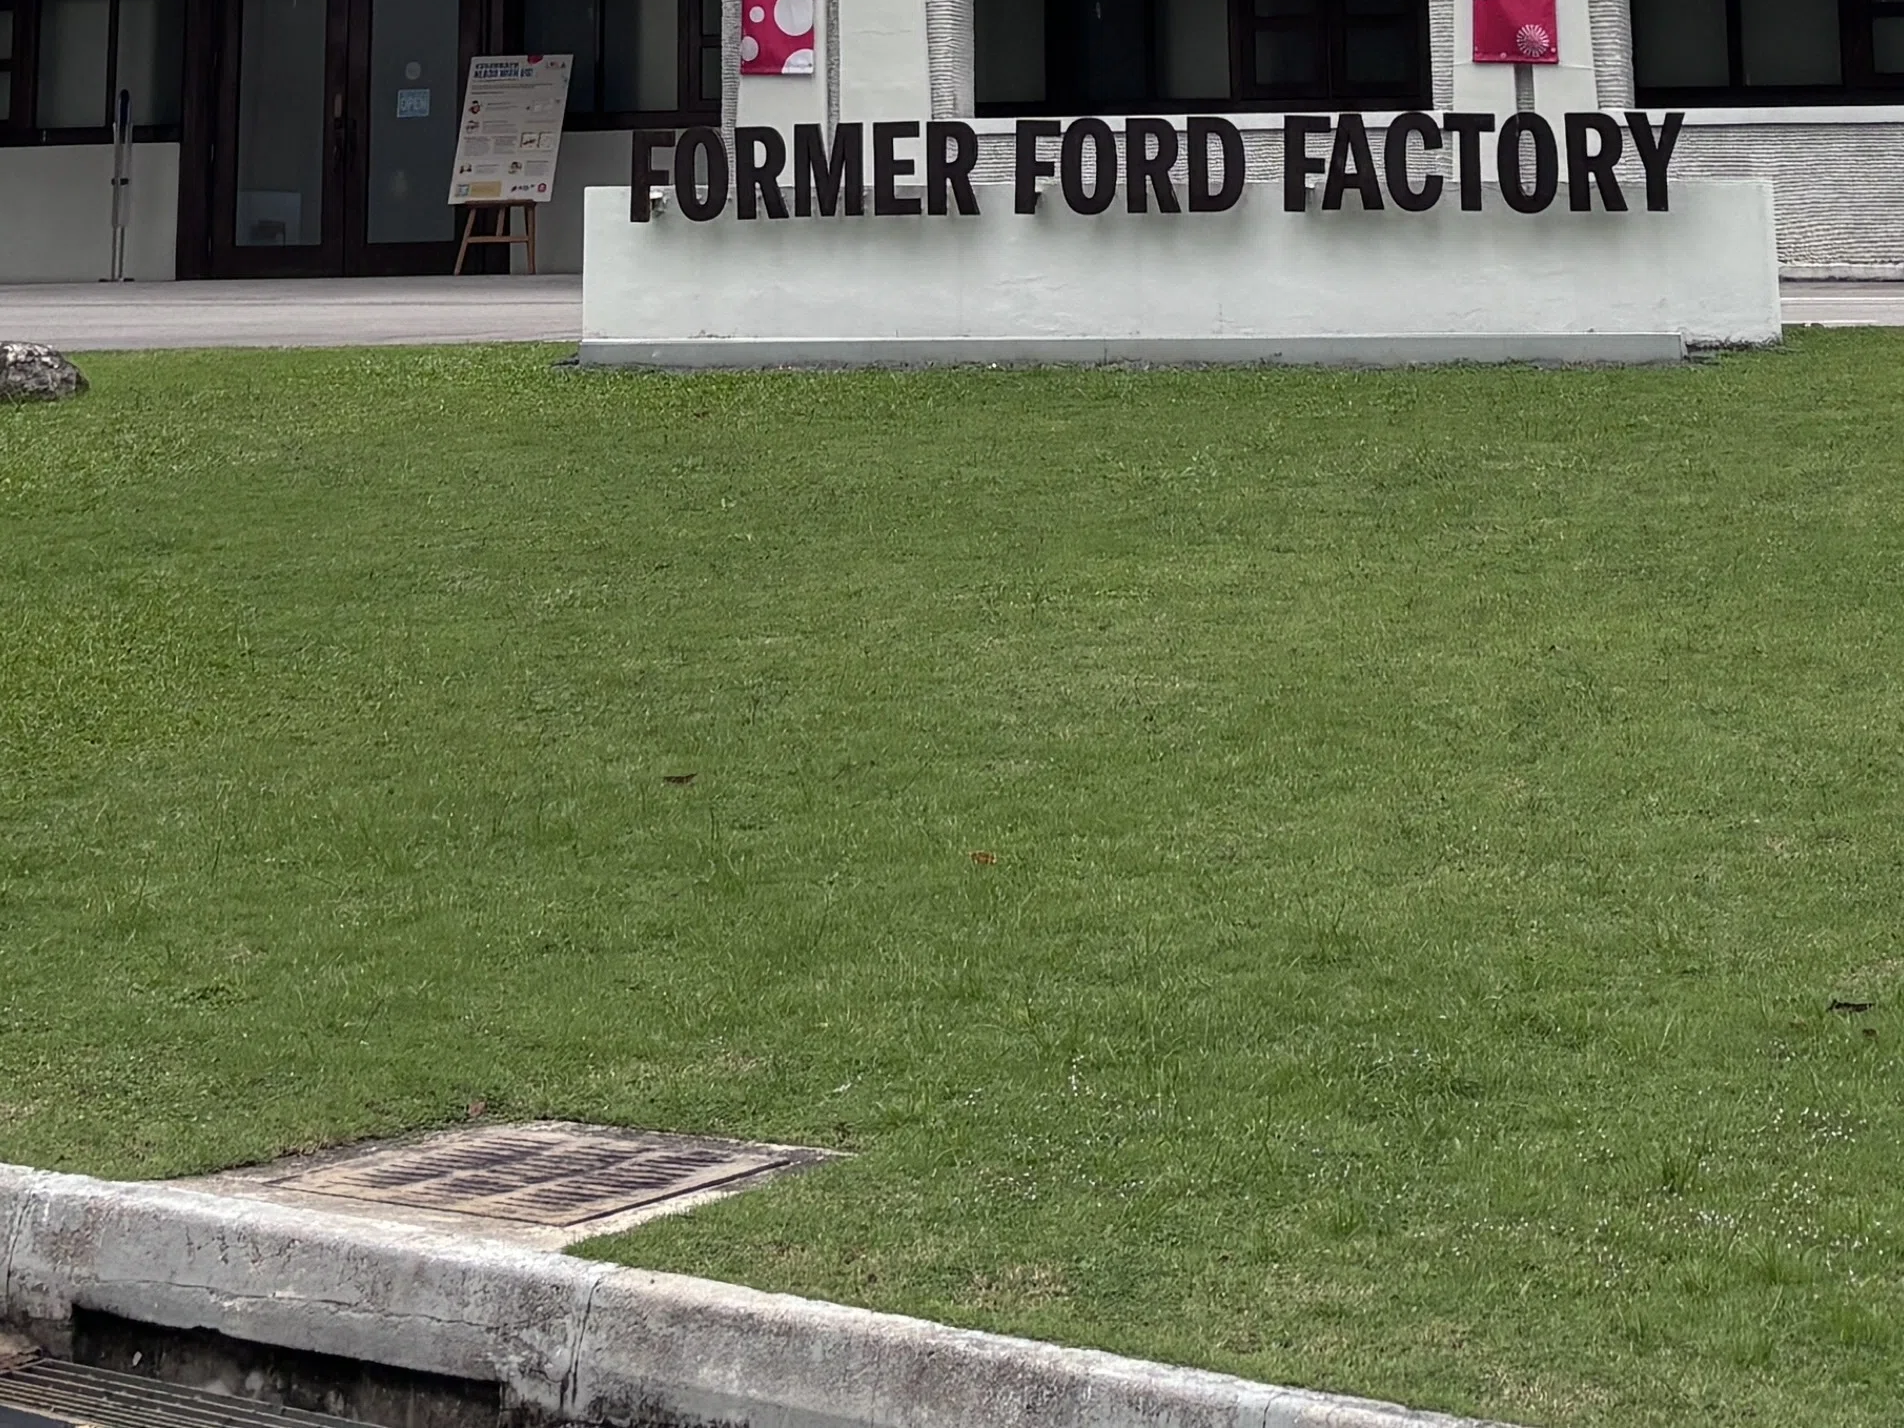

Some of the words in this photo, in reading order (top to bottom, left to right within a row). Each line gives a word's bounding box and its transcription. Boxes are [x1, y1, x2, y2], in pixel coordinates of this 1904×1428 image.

[630, 120, 981, 223] FORMER
[1014, 116, 1246, 216] FORD
[1283, 111, 1686, 214] FACTORY
